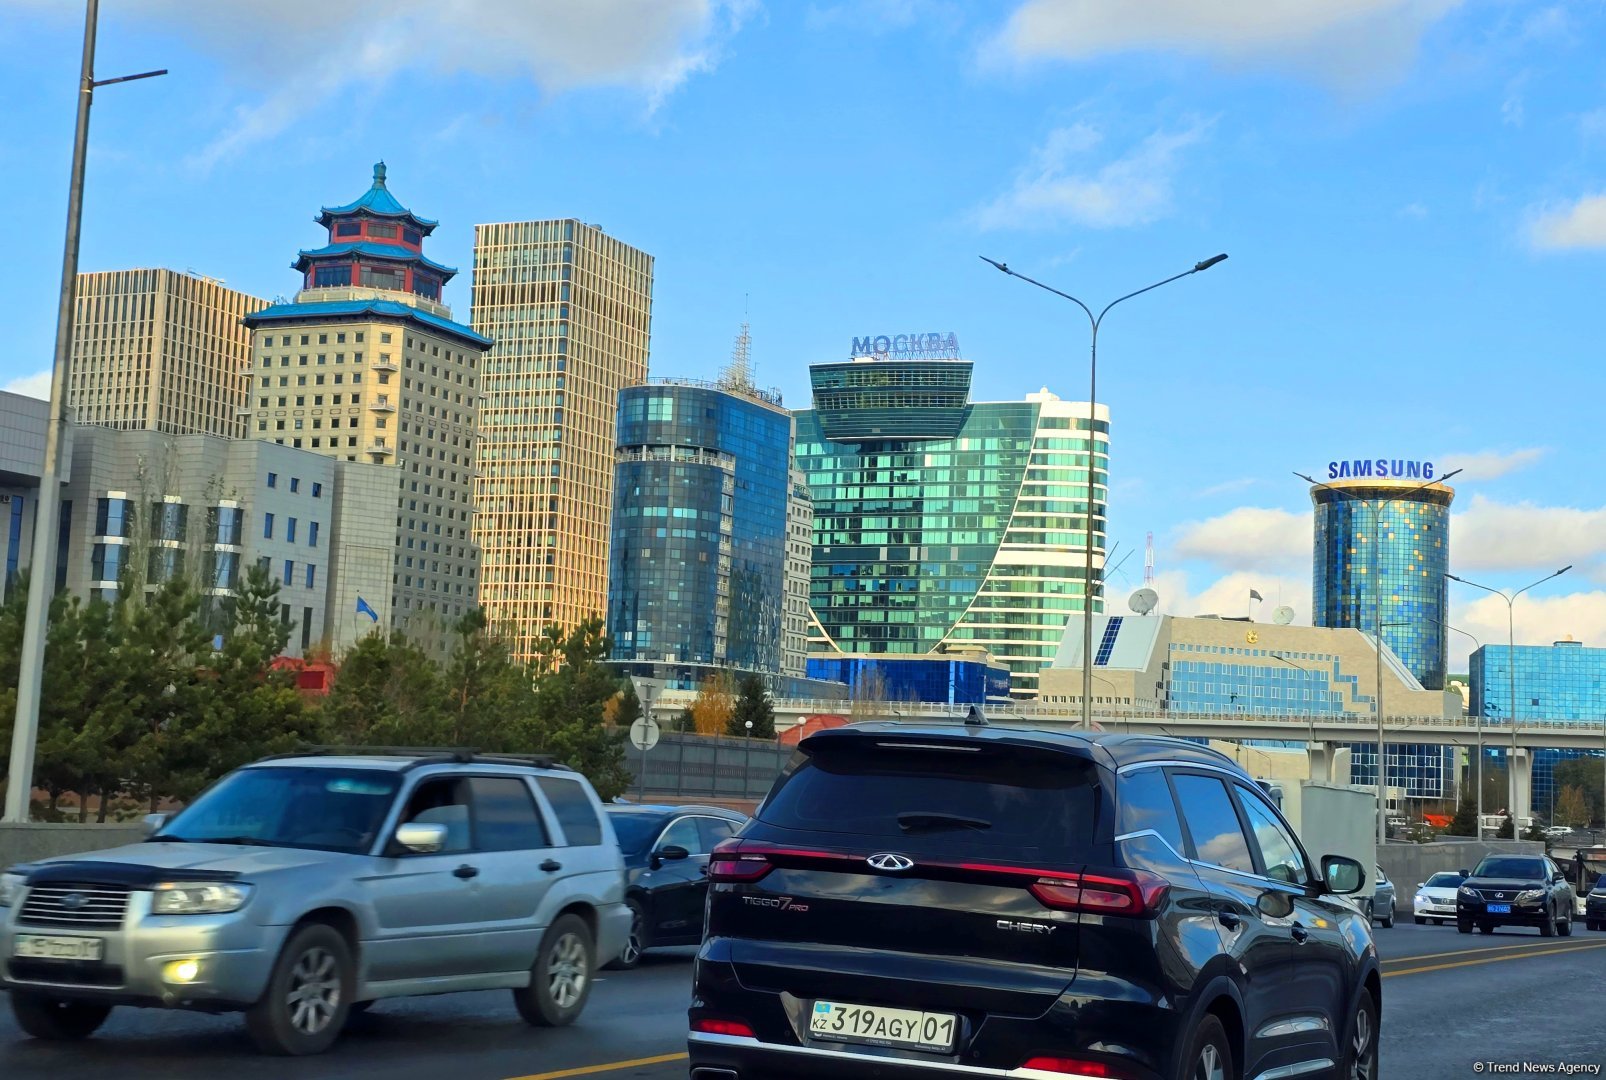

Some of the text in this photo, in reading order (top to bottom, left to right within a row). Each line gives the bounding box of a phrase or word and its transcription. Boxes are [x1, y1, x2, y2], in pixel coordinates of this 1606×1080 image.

[851, 332, 960, 355] МОСКВА
[1328, 459, 1434, 479] SAMSUNG
[742, 896, 780, 907] TIGGO
[778, 896, 792, 910] 7
[996, 920, 1057, 935] CHERY
[812, 1018, 827, 1030] KZ
[923, 1017, 953, 1043] 01
